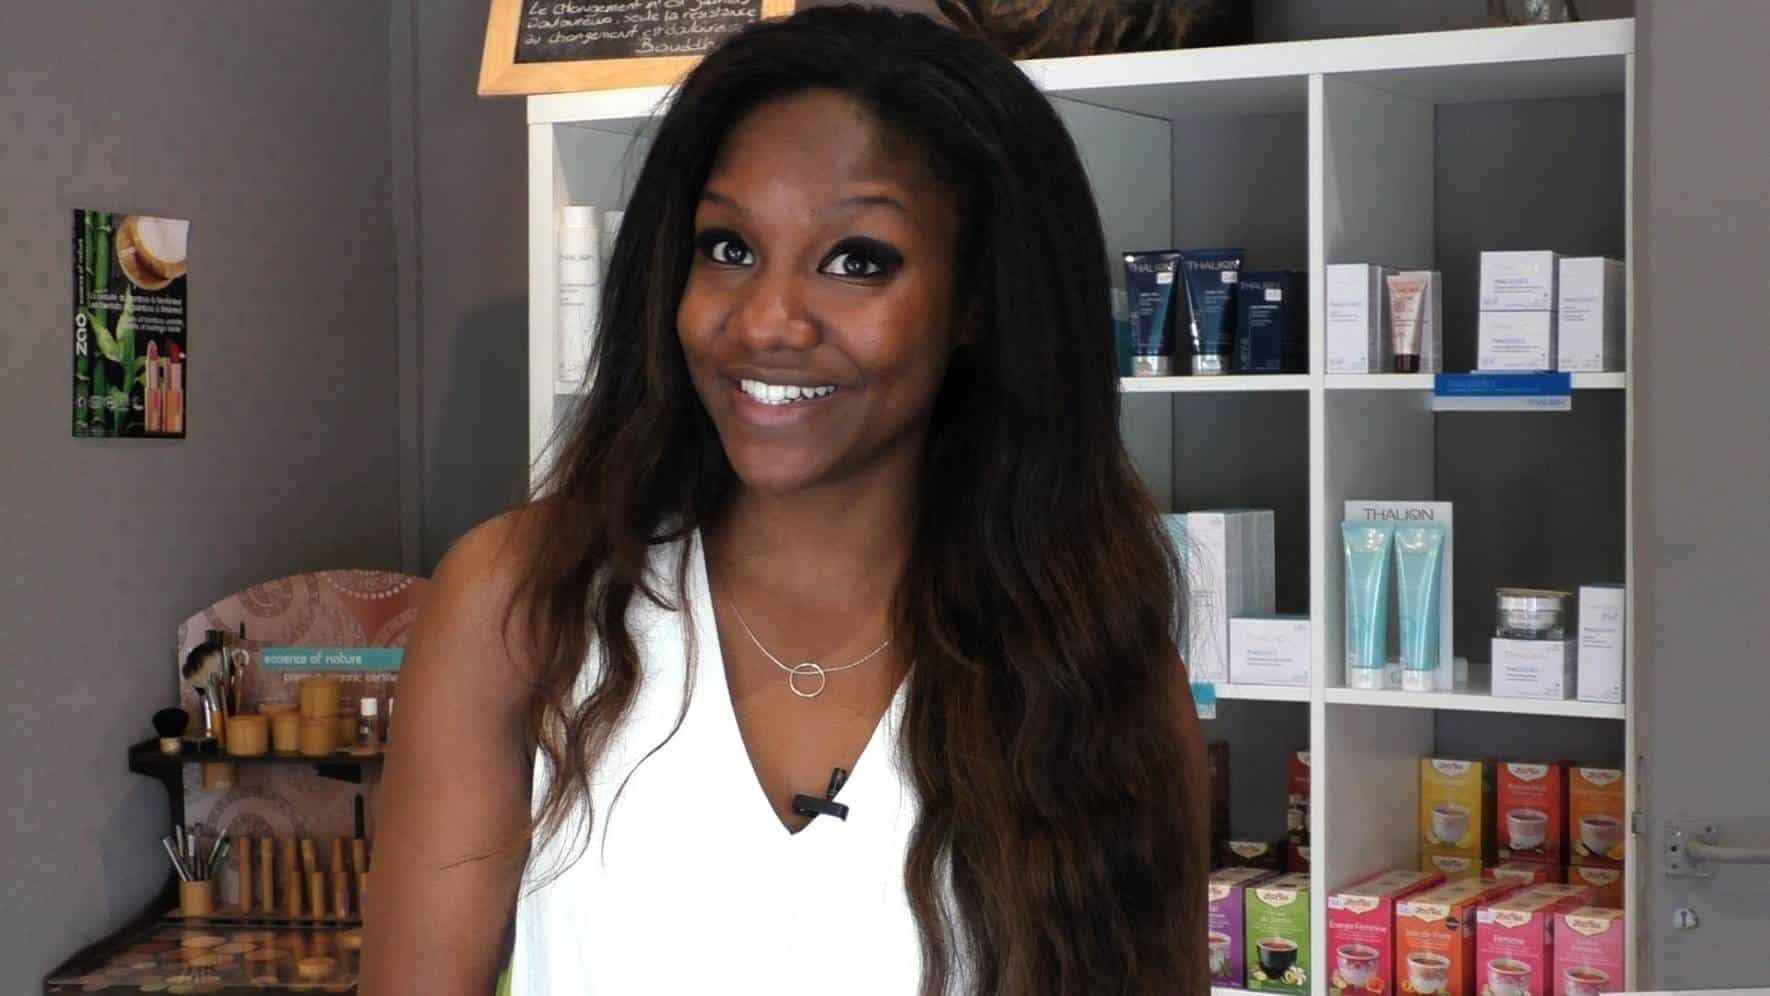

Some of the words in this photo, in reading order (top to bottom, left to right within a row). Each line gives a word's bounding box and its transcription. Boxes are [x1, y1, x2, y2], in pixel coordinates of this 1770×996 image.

[1363, 508, 1435, 521] THALION
[263, 654, 307, 665] essence
[310, 652, 322, 665] of
[325, 651, 363, 665] nature
